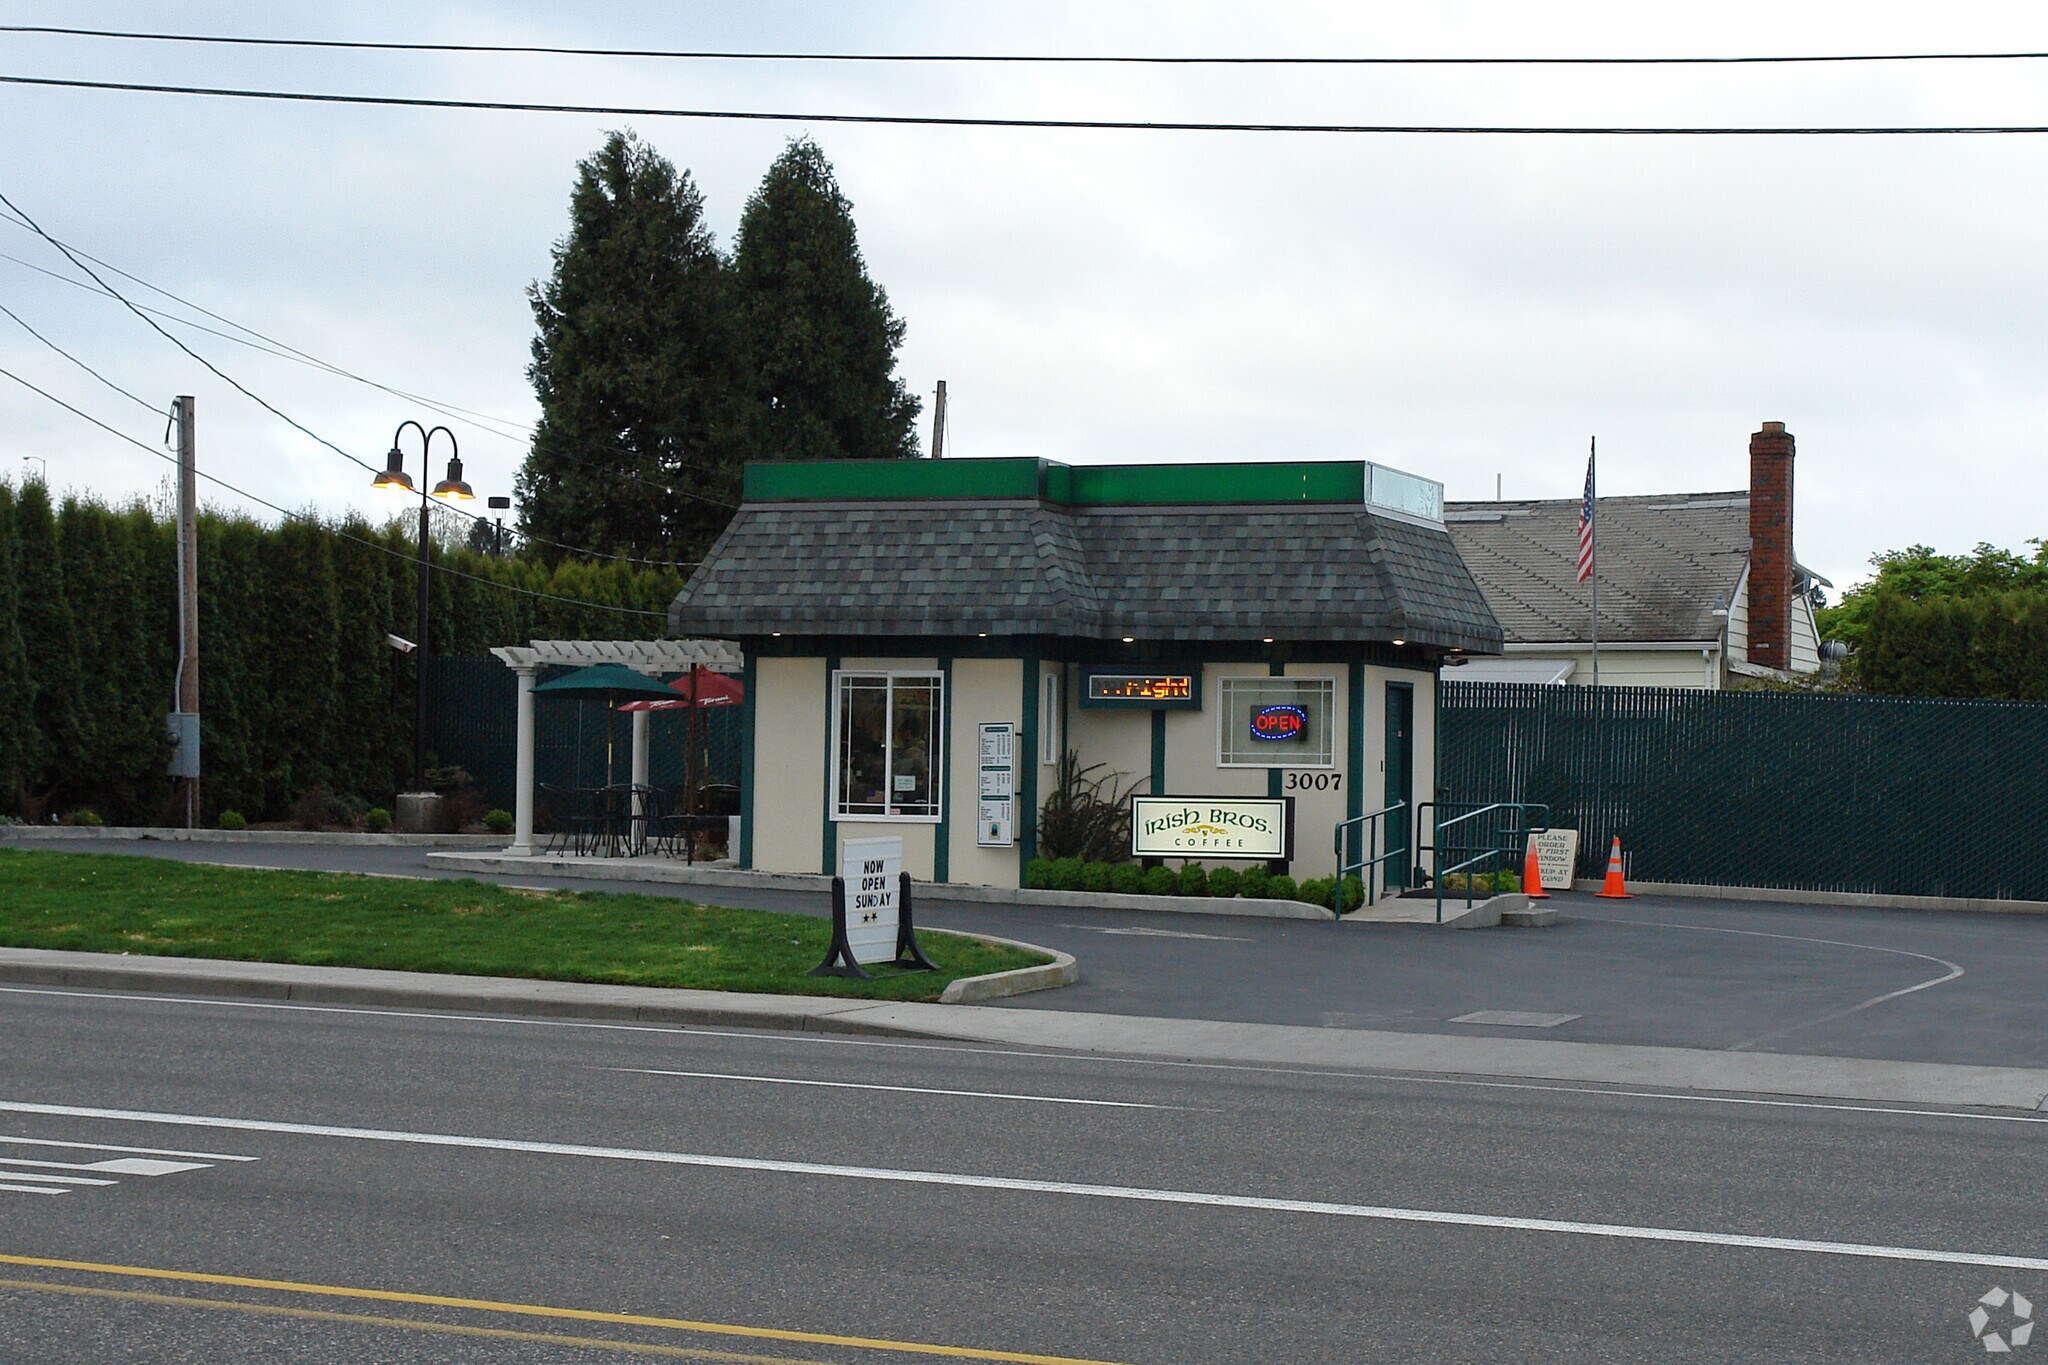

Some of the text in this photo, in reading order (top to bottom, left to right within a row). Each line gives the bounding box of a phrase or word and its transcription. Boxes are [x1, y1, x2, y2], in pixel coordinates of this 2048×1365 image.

[1256, 715, 1301, 731] OPEN
[1285, 773, 1342, 791] 3007
[1174, 838, 1244, 848] COFFEE
[1537, 834, 1568, 842] PLEASE
[1538, 841, 1566, 849] ORDER
[863, 860, 884, 874] NOW
[861, 877, 886, 891] OPEN
[855, 893, 892, 908] SUNDAY
